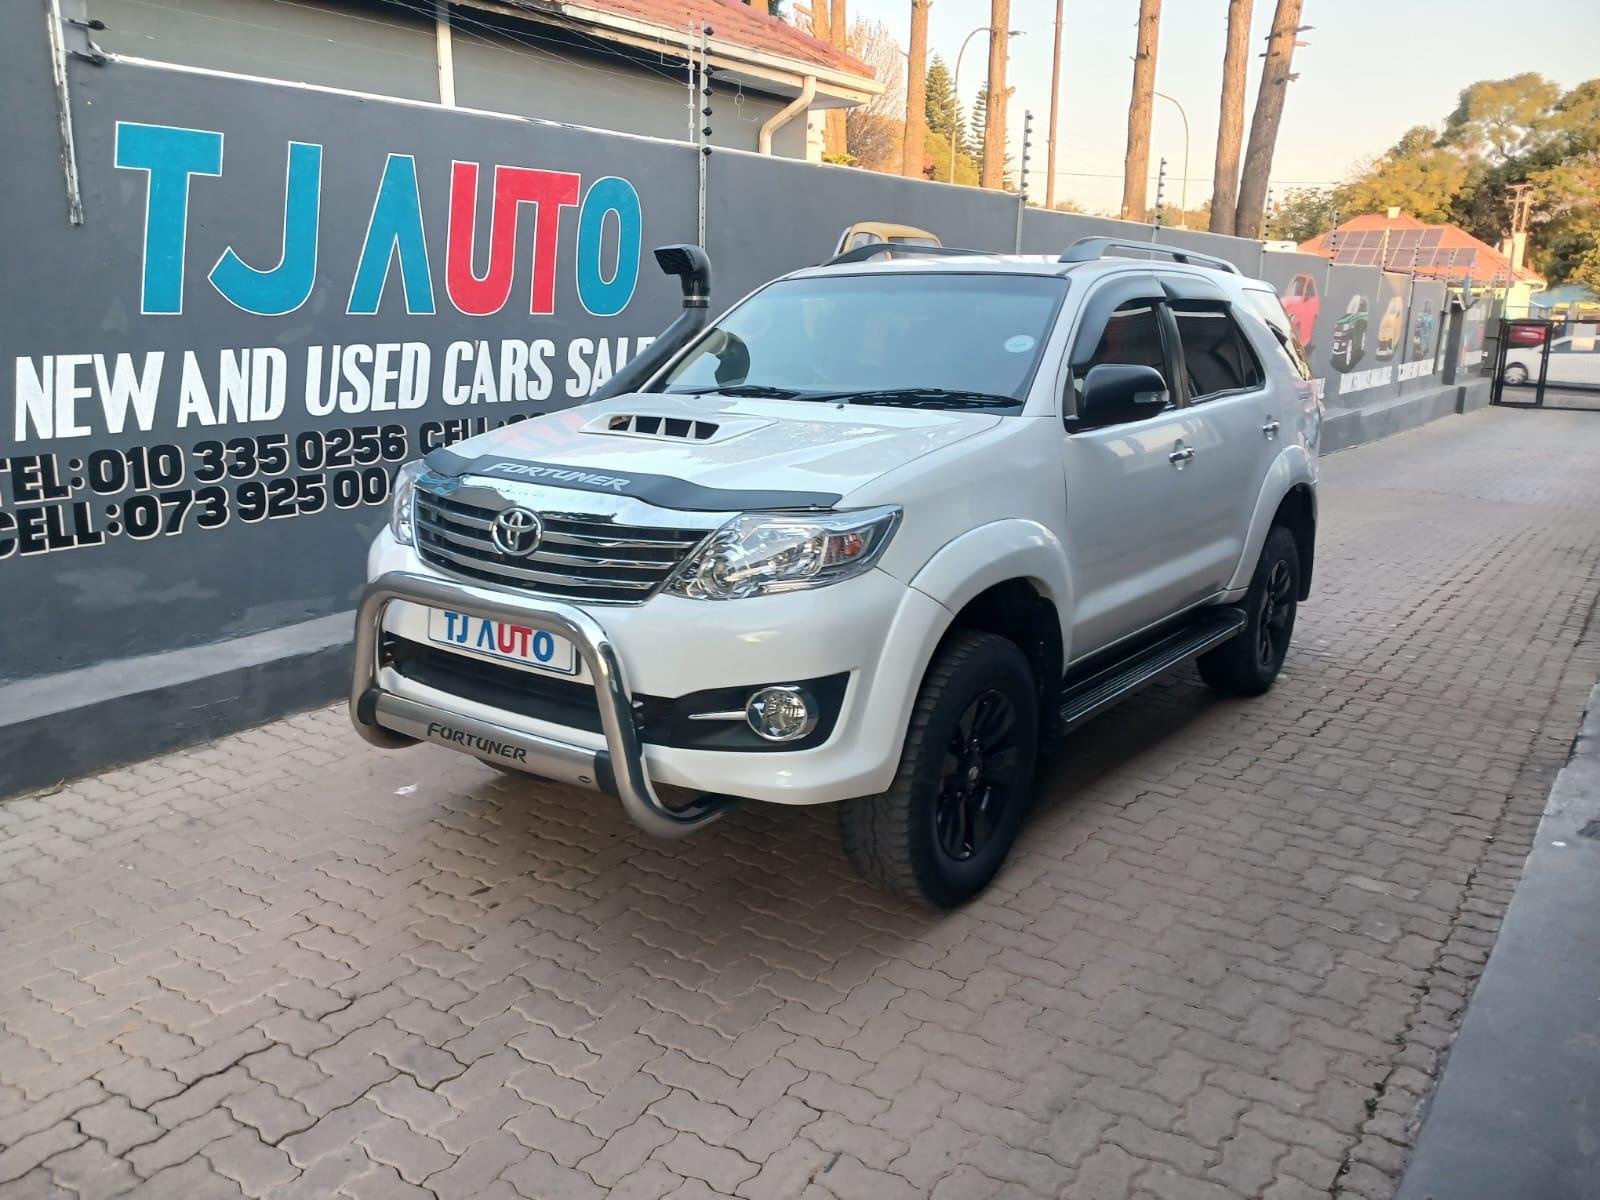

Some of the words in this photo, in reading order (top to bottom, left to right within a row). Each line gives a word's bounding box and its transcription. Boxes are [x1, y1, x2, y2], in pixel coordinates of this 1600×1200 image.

[115, 120, 323, 316] TJ
[345, 152, 642, 317] AUTO
[14, 351, 165, 442] NEW
[176, 347, 287, 429] AND
[304, 341, 430, 417] USED
[442, 338, 556, 406] CARS
[192, 433, 290, 484] 335
[296, 424, 408, 472] 0256
[483, 462, 632, 492] FORTUNER
[236, 473, 328, 524] 925
[444, 611, 469, 644] TJ
[477, 618, 555, 663] AUTO
[427, 721, 528, 764] FORTUNER
